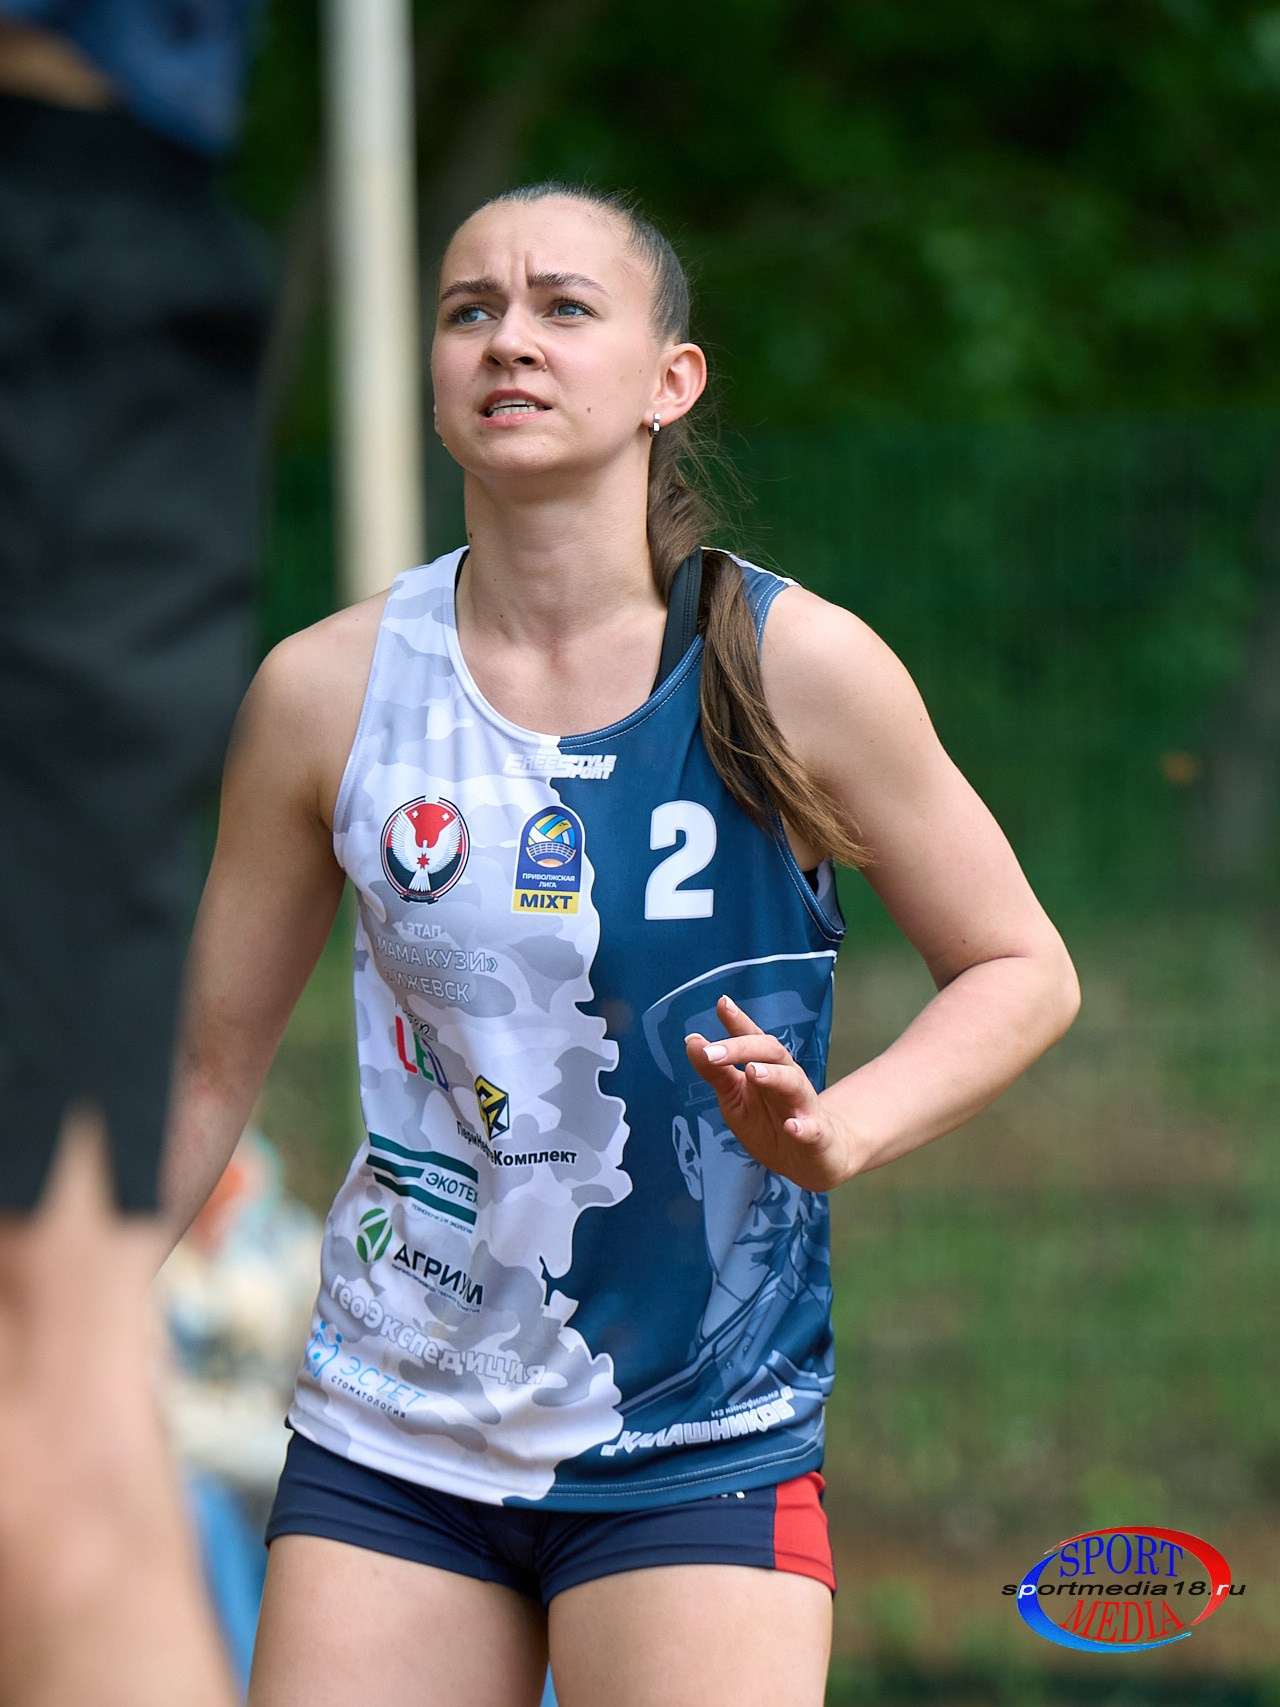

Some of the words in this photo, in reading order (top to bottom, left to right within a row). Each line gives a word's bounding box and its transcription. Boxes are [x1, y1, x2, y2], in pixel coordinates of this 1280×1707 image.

[644, 800, 717, 920] 2
[522, 872, 576, 882] ПРИВОЛЖСКАЯ
[519, 893, 573, 909] MIXT
[406, 922, 441, 938] ЭТАП
[331, 1374, 407, 1419] СТОМАТОЛОГИЯ
[339, 1356, 427, 1407] ЭСТЕТ
